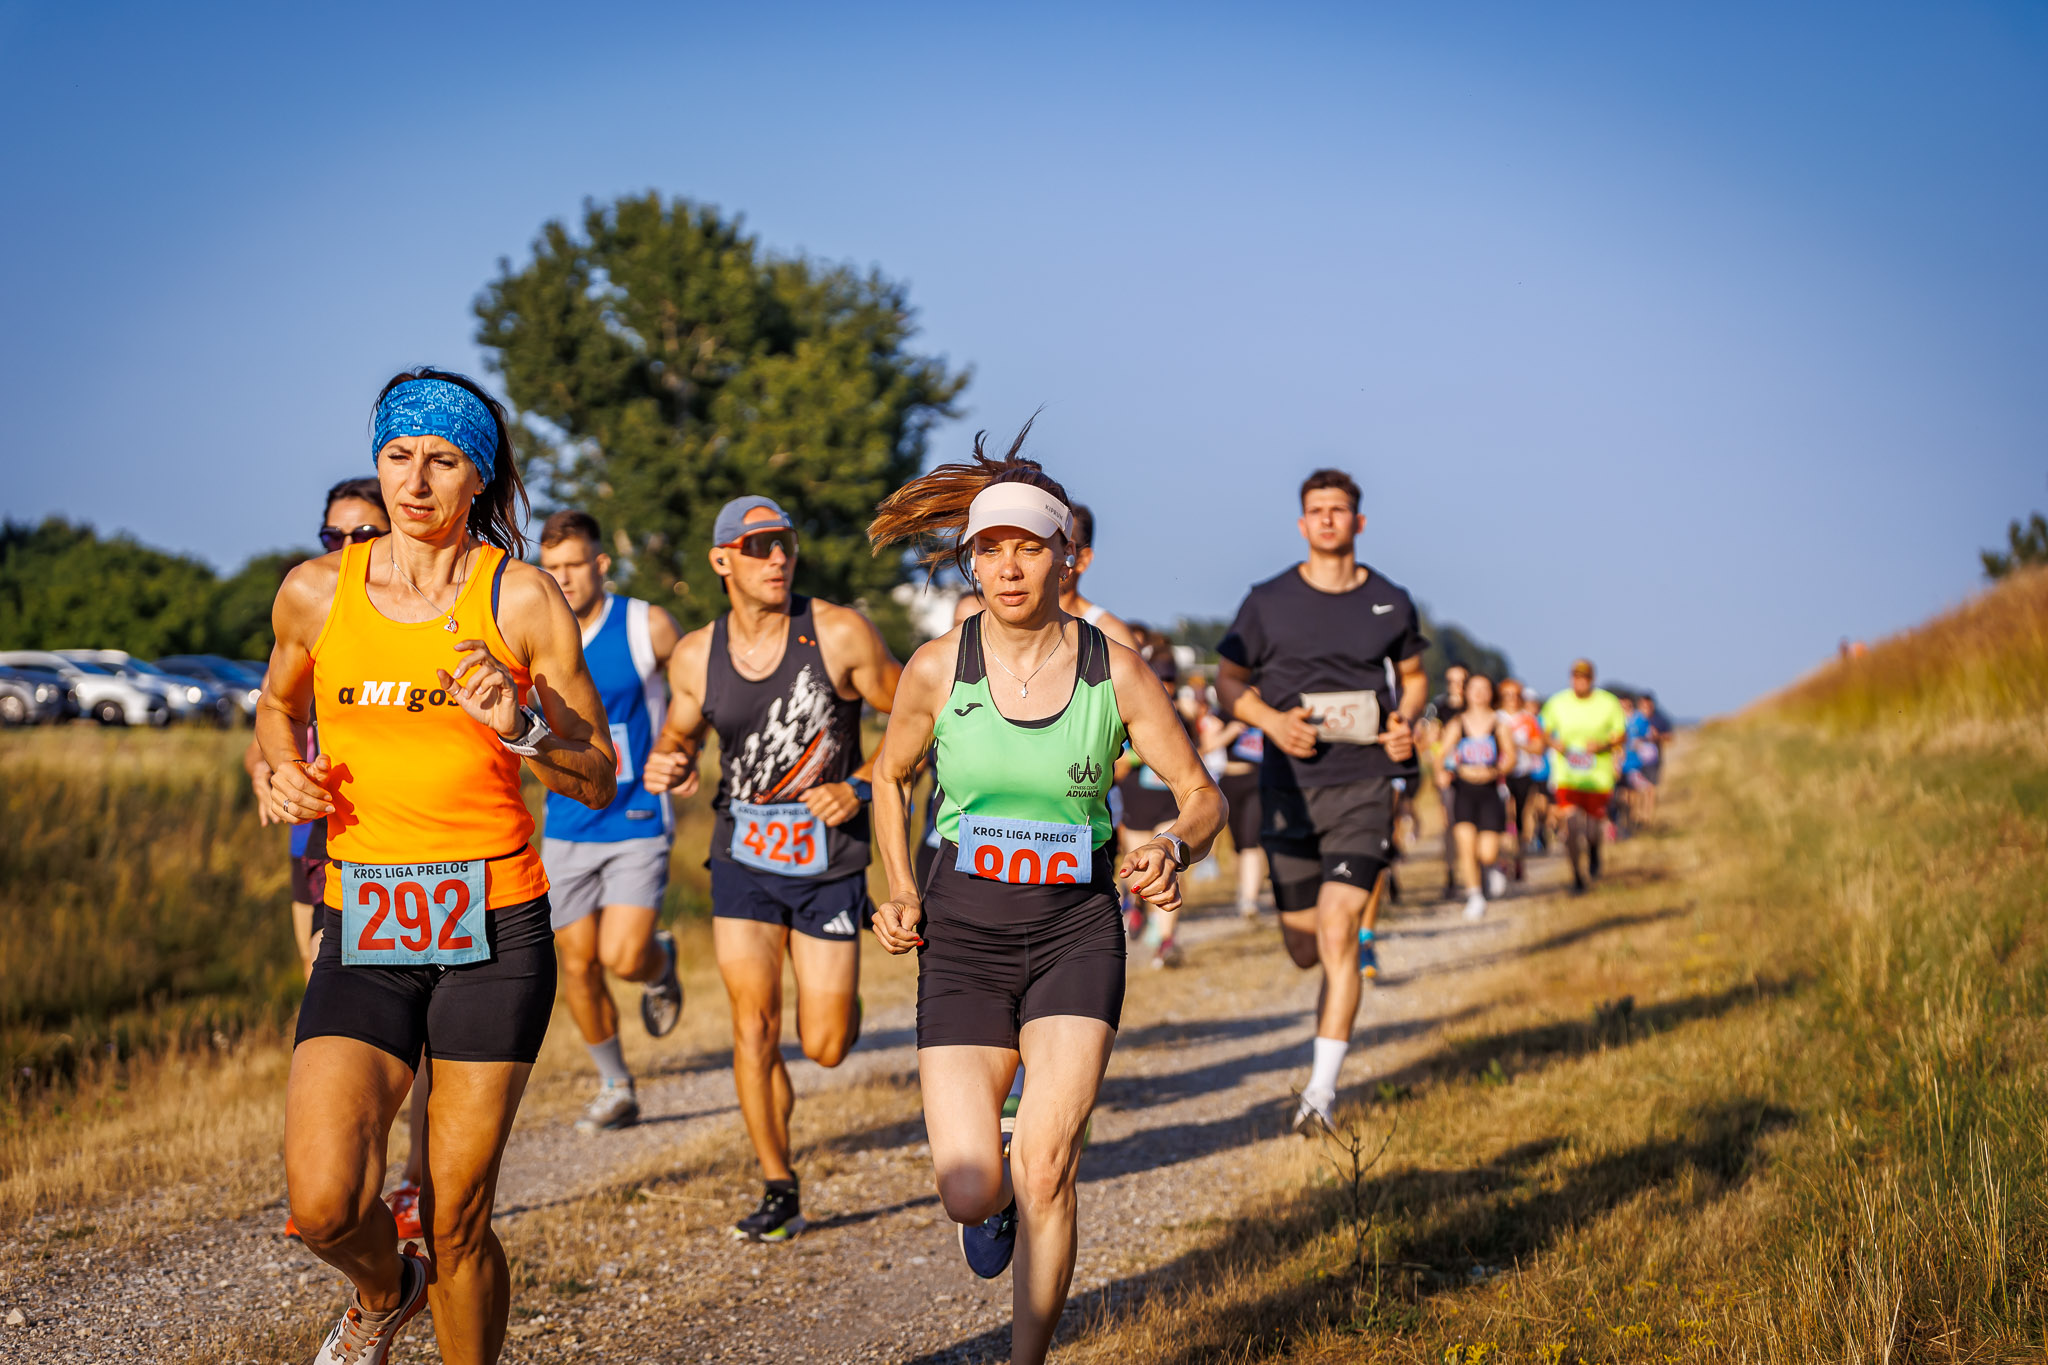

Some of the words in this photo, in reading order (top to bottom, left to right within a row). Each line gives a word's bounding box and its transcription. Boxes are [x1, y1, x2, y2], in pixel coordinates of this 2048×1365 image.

[1066, 790, 1099, 798] ADVANCE
[743, 822, 815, 865] 425
[973, 827, 1002, 838] KROS
[1007, 830, 1031, 840] LIGA
[1035, 833, 1077, 843] PRELOG
[354, 868, 382, 879] KROS
[385, 867, 413, 878] LIGA
[417, 862, 469, 876] PRELOG
[973, 846, 1077, 884] 806
[358, 879, 473, 952] 292
